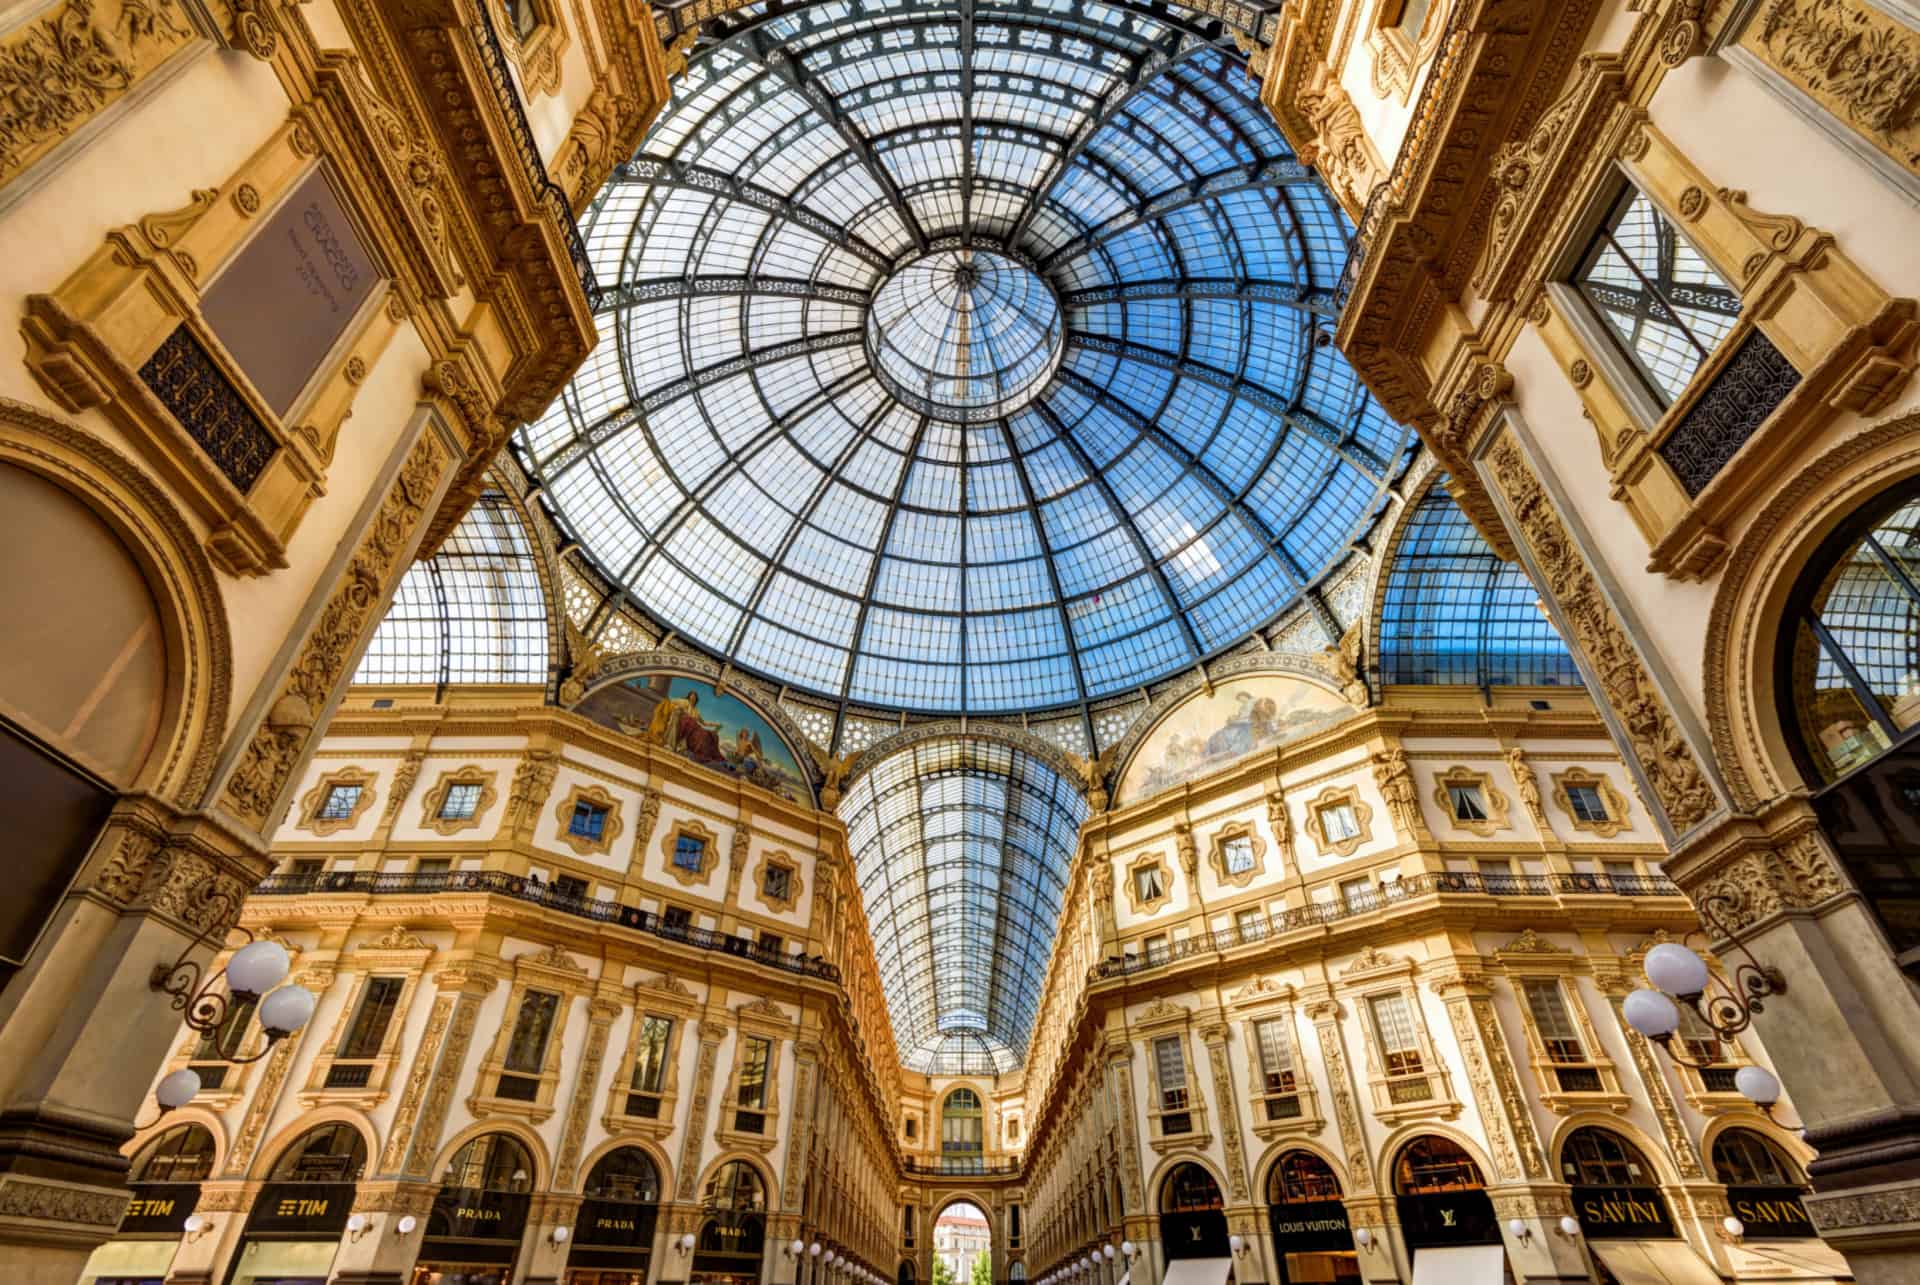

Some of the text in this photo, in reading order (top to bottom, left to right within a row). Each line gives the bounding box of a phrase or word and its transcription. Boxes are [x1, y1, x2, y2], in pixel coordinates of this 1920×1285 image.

[143, 1200, 175, 1216] TIM
[296, 1200, 328, 1216] TIM
[456, 1208, 502, 1221] PRADA
[1584, 1201, 1661, 1223] SAVINI
[1737, 1201, 1809, 1223] SAVIN
[596, 1218, 635, 1231] PRADA
[1279, 1218, 1346, 1233] LOUIS VUITTON
